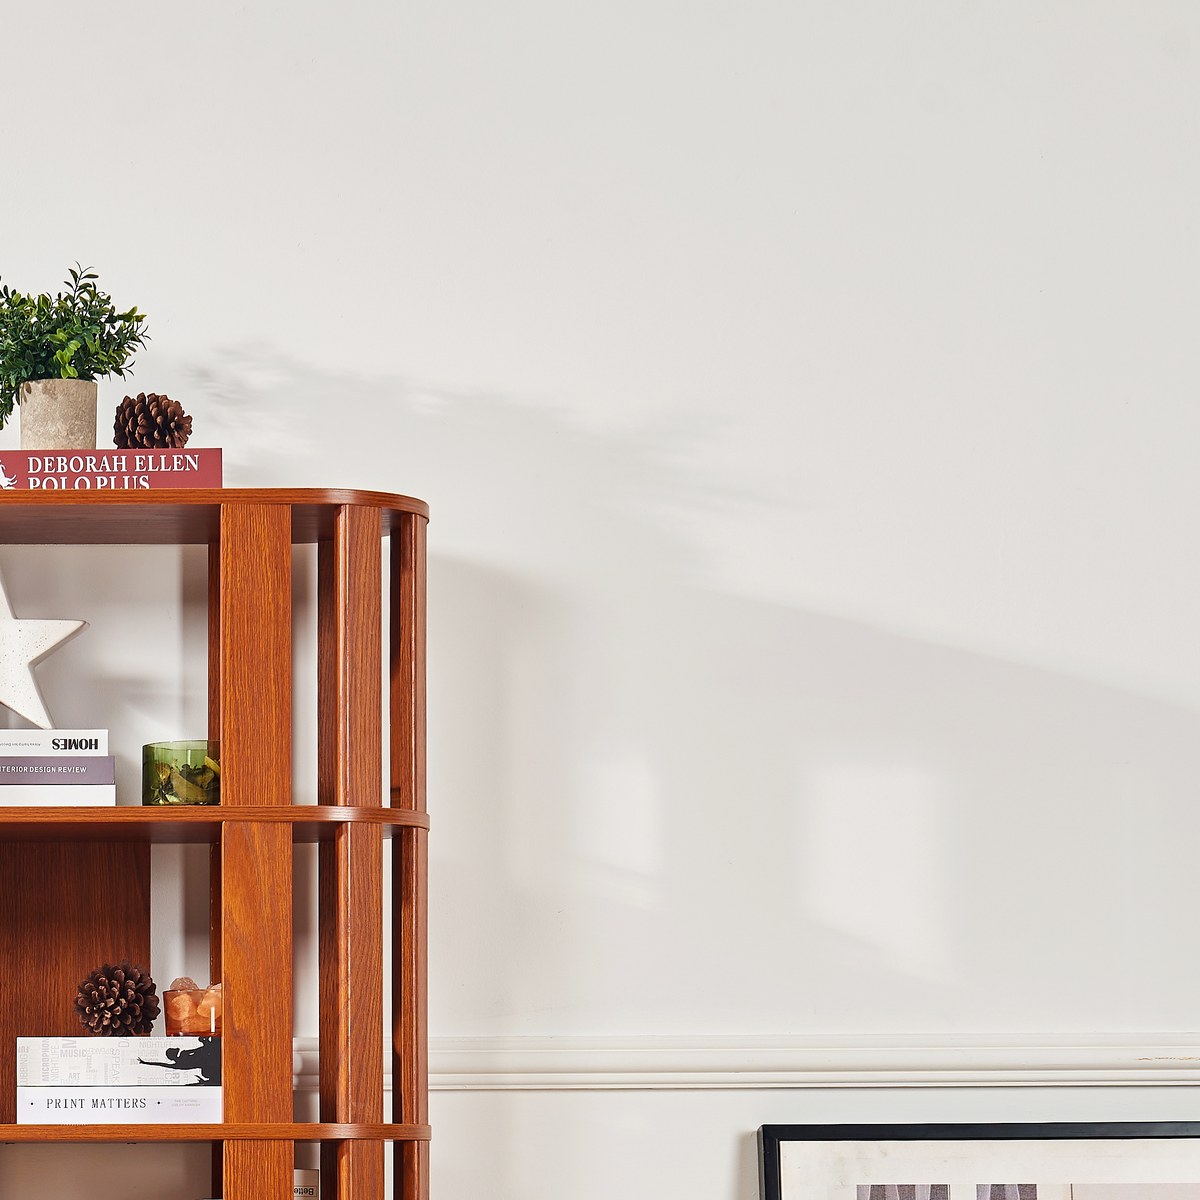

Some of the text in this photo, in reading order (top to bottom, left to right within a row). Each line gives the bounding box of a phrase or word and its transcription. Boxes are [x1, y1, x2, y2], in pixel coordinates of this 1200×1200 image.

[27, 454, 199, 474] DEBORAH ELLEN
[28, 474, 150, 489] POLO PLUS
[51, 738, 99, 750] HOMES
[60, 1049, 87, 1058] MUSIC
[46, 1097, 147, 1109] PRINT MATTERS
